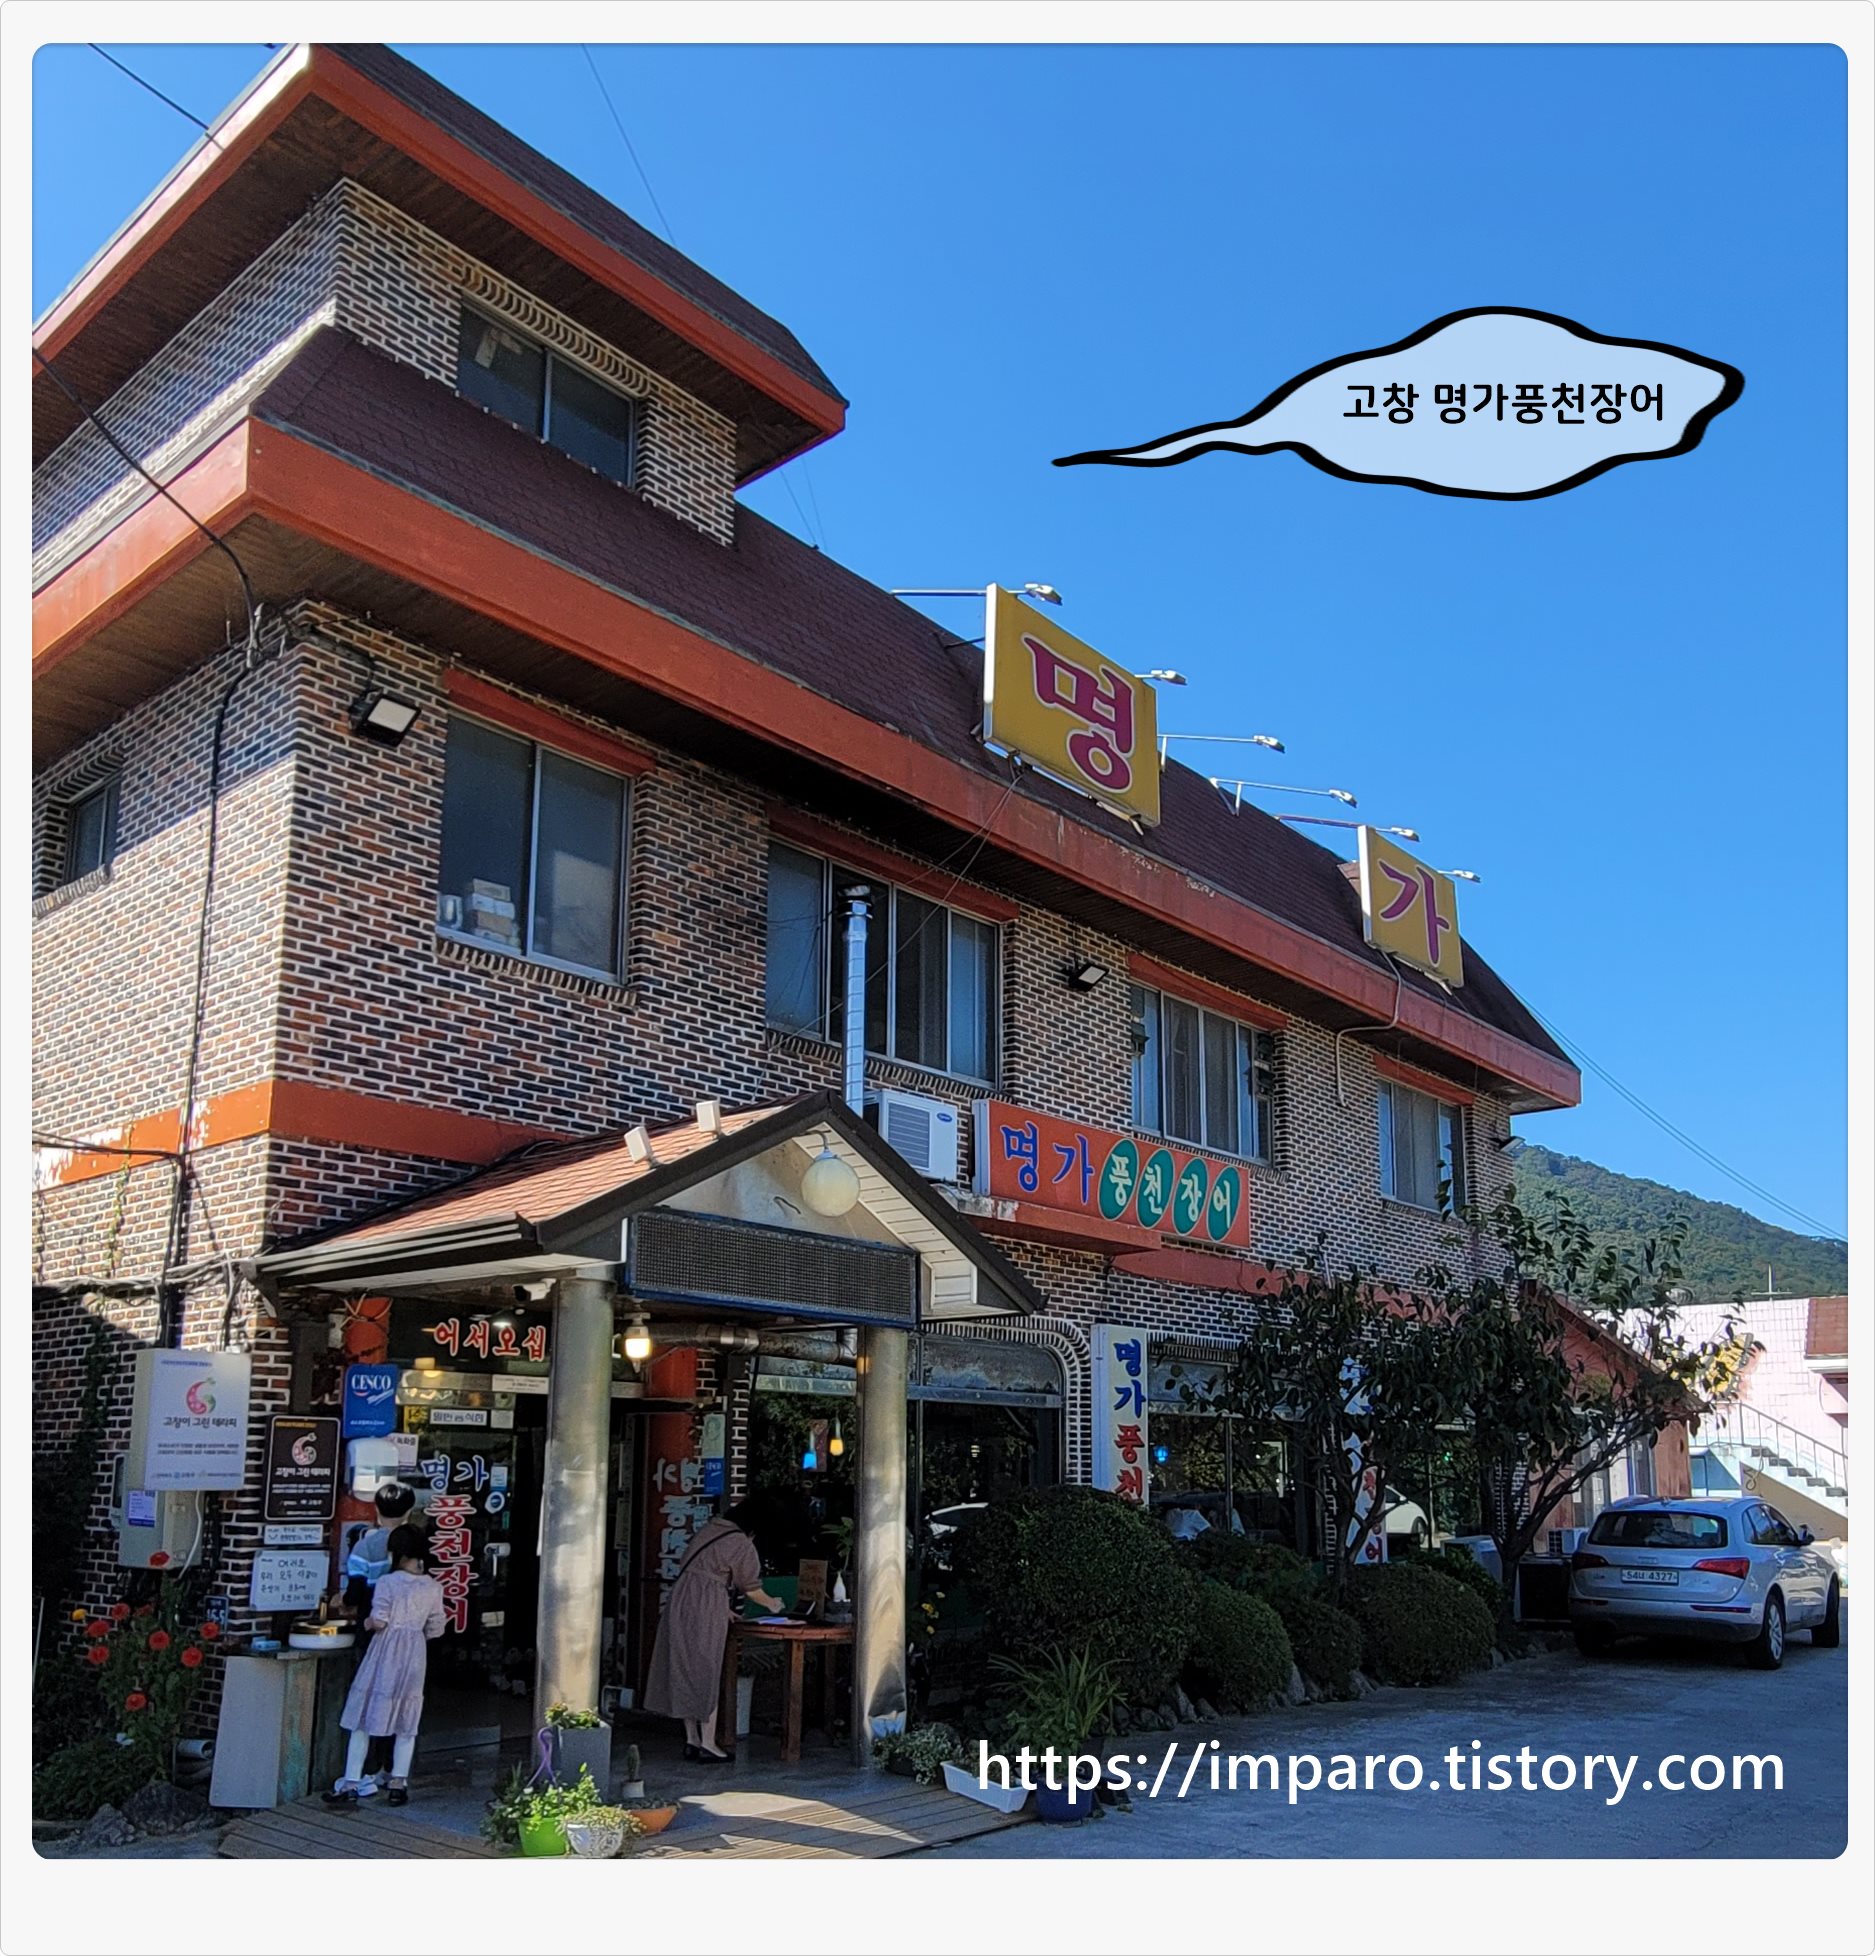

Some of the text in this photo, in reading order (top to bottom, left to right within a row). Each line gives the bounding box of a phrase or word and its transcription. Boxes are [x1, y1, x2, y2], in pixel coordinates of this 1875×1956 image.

[1020, 633, 1134, 794] 명
[1376, 858, 1450, 966] 가
[1000, 1120, 1232, 1230] 명가 풍천장어
[433, 1317, 547, 1362] 어서오십
[192, 1416, 210, 1429] 그린
[420, 1454, 490, 1493] 명가
